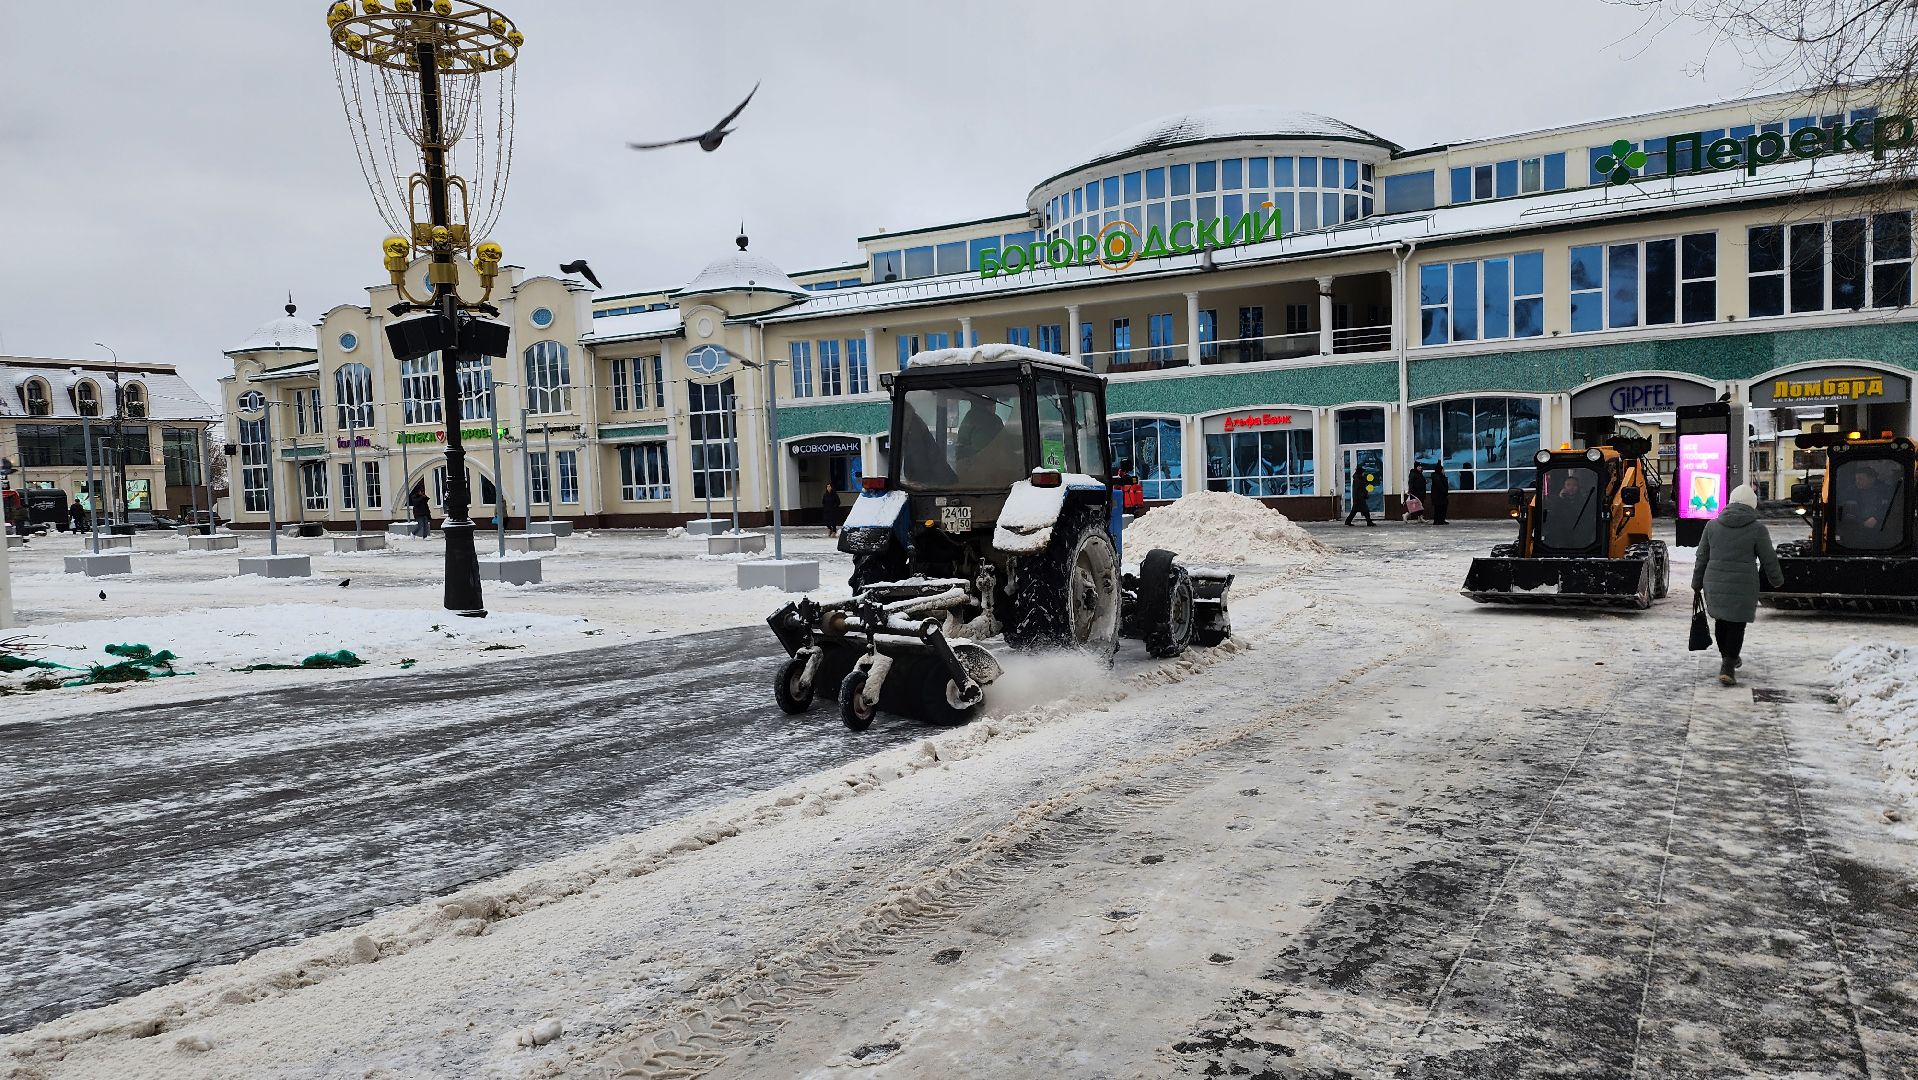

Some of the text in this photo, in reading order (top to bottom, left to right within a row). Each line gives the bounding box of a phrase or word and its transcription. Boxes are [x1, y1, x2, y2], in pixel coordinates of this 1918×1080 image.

[979, 202, 1283, 278] БОГОРОДСКИЙ
[1773, 376, 1884, 400] Ломбард
[1263, 413, 1292, 425] Банк
[800, 442, 859, 453] СОВКОМБАНК
[945, 508, 969, 518] 2410
[959, 519, 970, 528] 50
